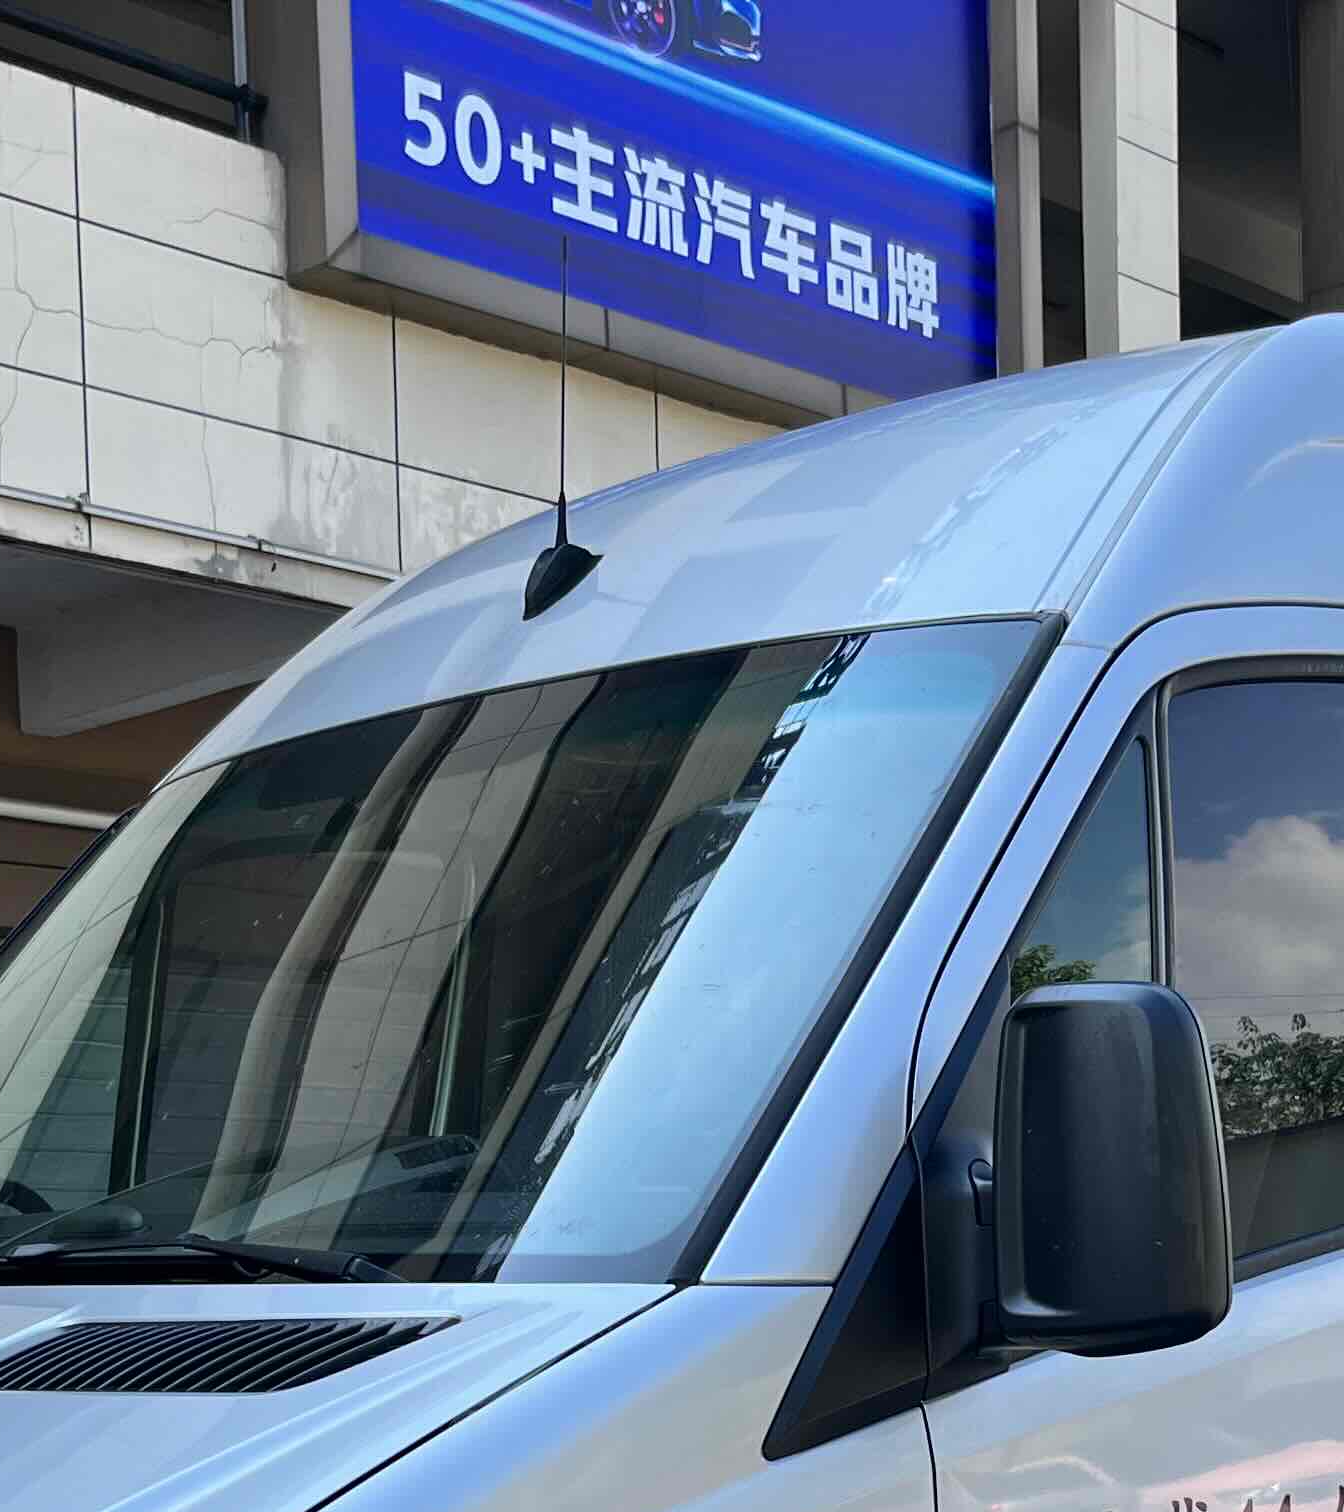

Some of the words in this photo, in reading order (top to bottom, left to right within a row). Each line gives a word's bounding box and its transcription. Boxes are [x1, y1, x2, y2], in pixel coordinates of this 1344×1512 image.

[403, 71, 940, 338] 50+主流汽车品牌
